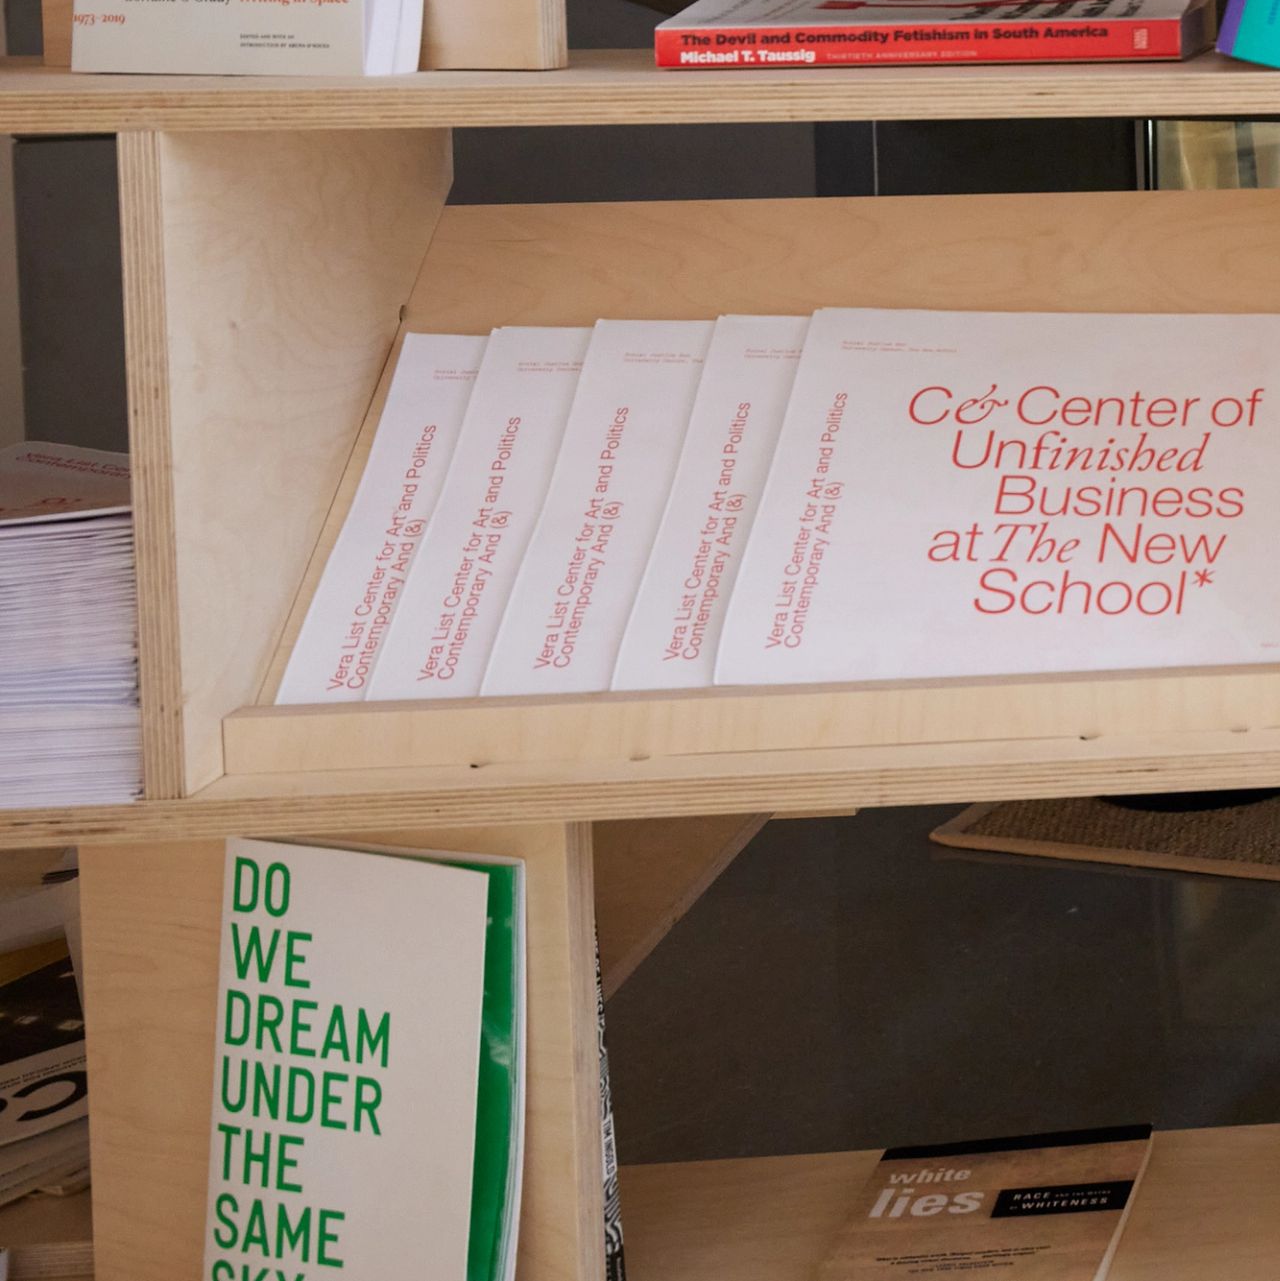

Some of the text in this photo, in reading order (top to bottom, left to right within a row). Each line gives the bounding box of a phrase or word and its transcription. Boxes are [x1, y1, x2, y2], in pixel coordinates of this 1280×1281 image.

[681, 27, 1108, 46] The Devil and Commodity Fetishism in South America
[681, 50, 738, 64] Michael
[741, 50, 755, 63] T.
[758, 49, 816, 64] Taussig
[827, 51, 873, 60] THIRTIETH
[940, 50, 978, 58] EDITION
[1016, 386, 1199, 427] Center
[1211, 388, 1265, 427] of
[952, 430, 1211, 471] Unfinished
[994, 475, 1245, 518] Business
[765, 392, 849, 650] Vera List Center for Art and Politics
[927, 522, 1227, 564] at The New
[783, 481, 845, 649] Contemporary And (&)
[232, 856, 292, 918] DO
[231, 923, 313, 989] WE
[224, 989, 391, 1069] DREAM
[220, 1056, 383, 1136] UNDER
[217, 1123, 306, 1194] THE
[889, 1168, 972, 1185] white
[868, 1188, 985, 1219] lies
[1013, 1190, 1051, 1202] RACE
[1020, 1197, 1110, 1211] WHITENESS
[213, 1193, 346, 1269] SAME
